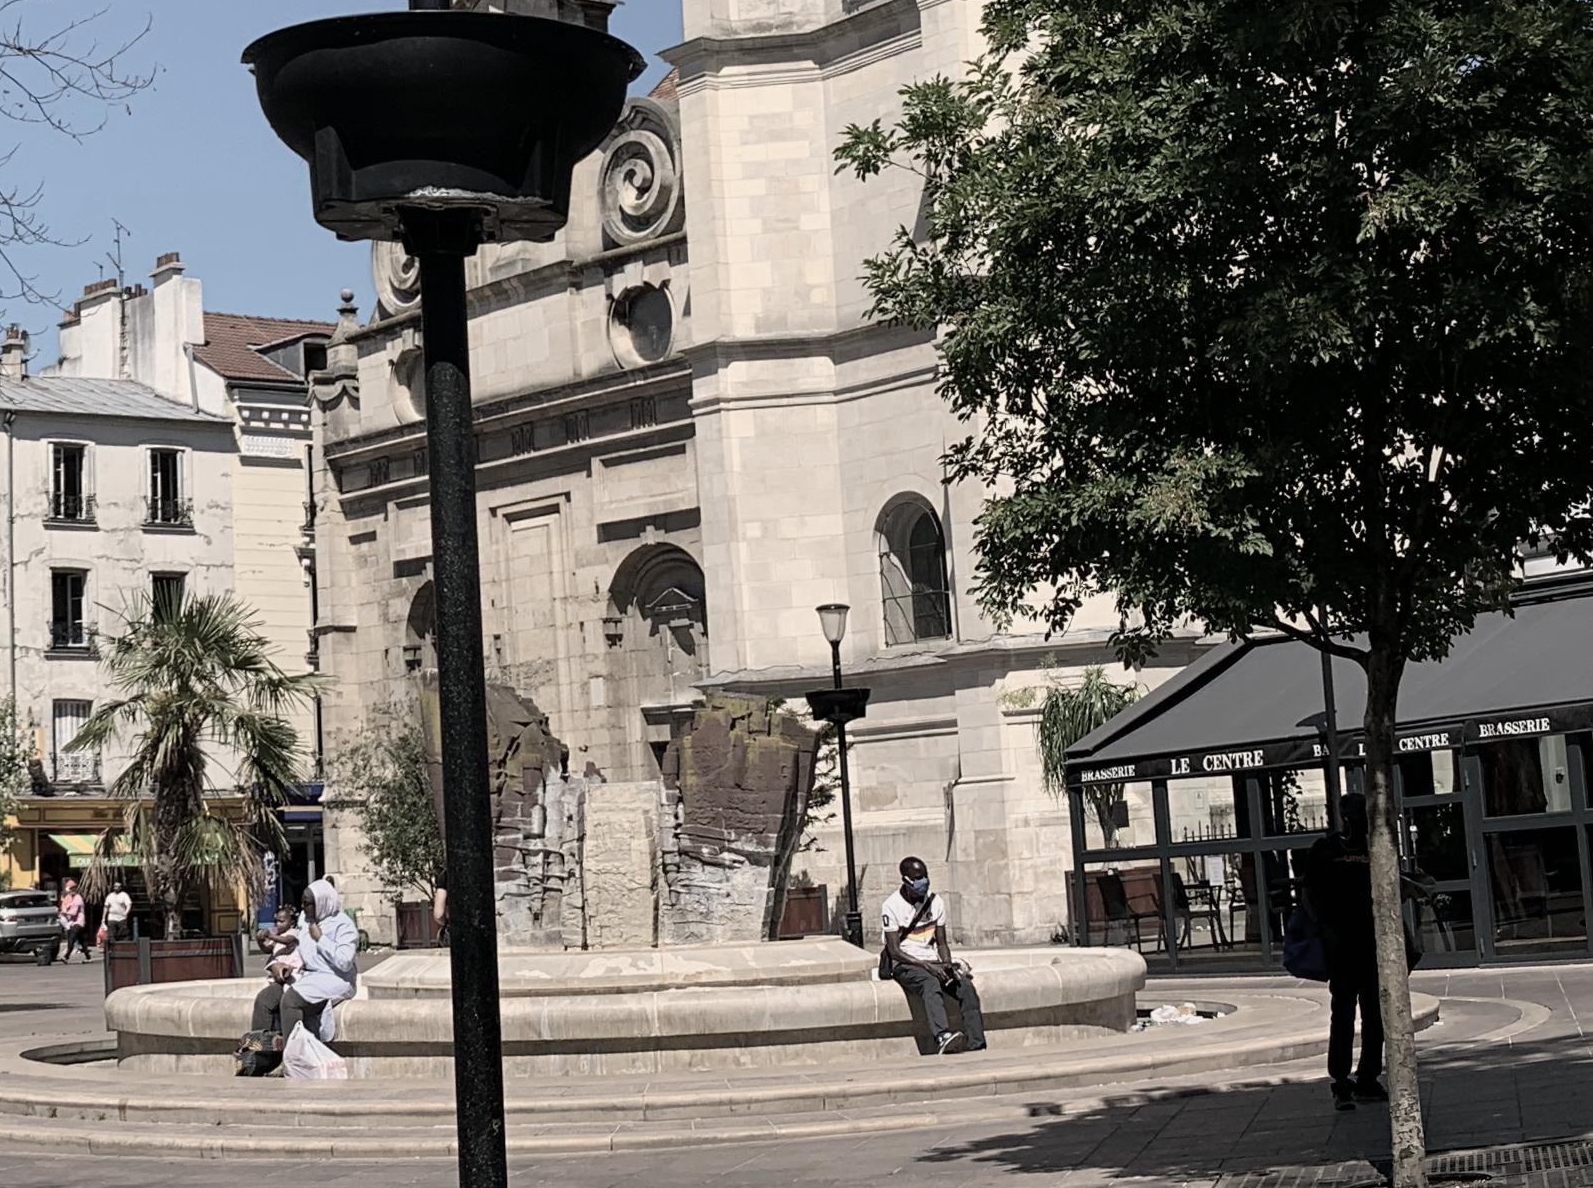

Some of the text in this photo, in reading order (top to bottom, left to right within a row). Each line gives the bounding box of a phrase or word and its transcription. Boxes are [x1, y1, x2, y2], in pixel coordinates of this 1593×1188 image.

[1479, 717, 1550, 737] BRASSERIE
[1313, 743, 1330, 757] BA
[1398, 733, 1449, 751] CENTRE
[1081, 750, 1263, 782] BRASSERIE LE CENTRE
